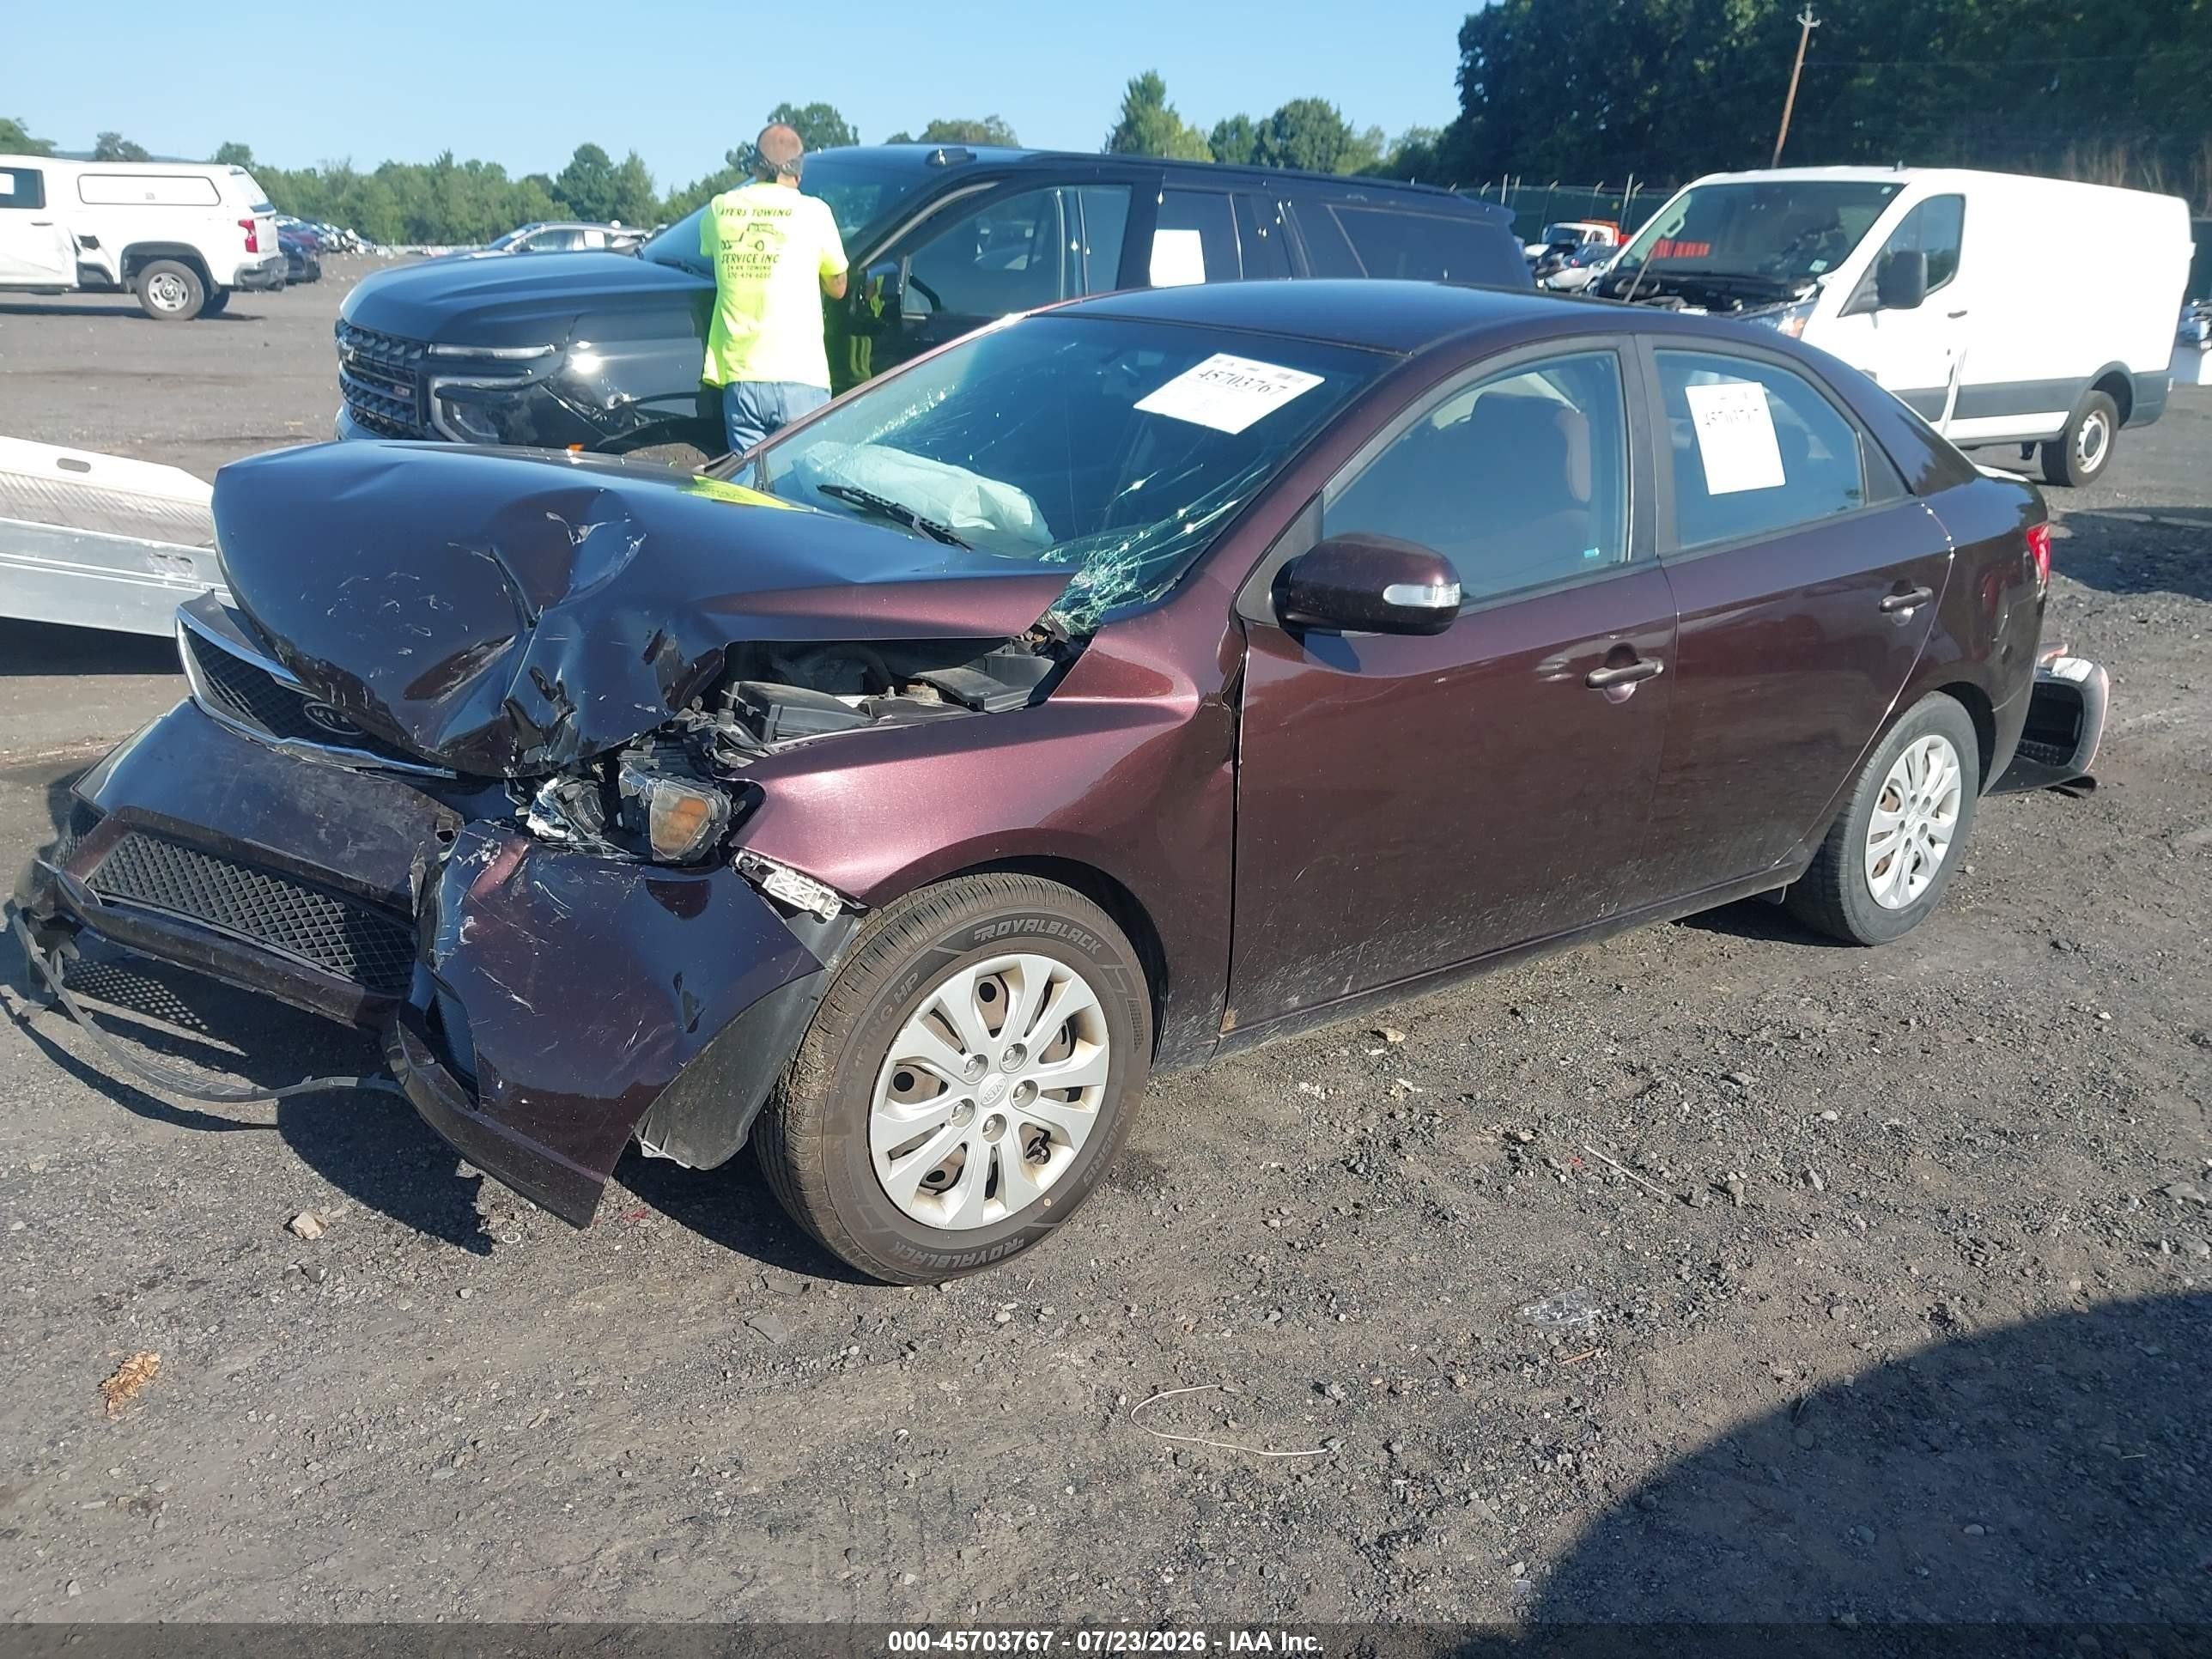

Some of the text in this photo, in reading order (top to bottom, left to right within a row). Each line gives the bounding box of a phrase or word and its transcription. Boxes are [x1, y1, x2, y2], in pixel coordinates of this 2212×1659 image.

[751, 208, 793, 217] TOWING
[721, 253, 780, 264] SERVICE INC
[1198, 369, 1289, 396] 45703767
[974, 919, 1103, 955] ROYALBLACK
[893, 972, 919, 1004] HP
[888, 1237, 1024, 1268] ROYALBLACK
